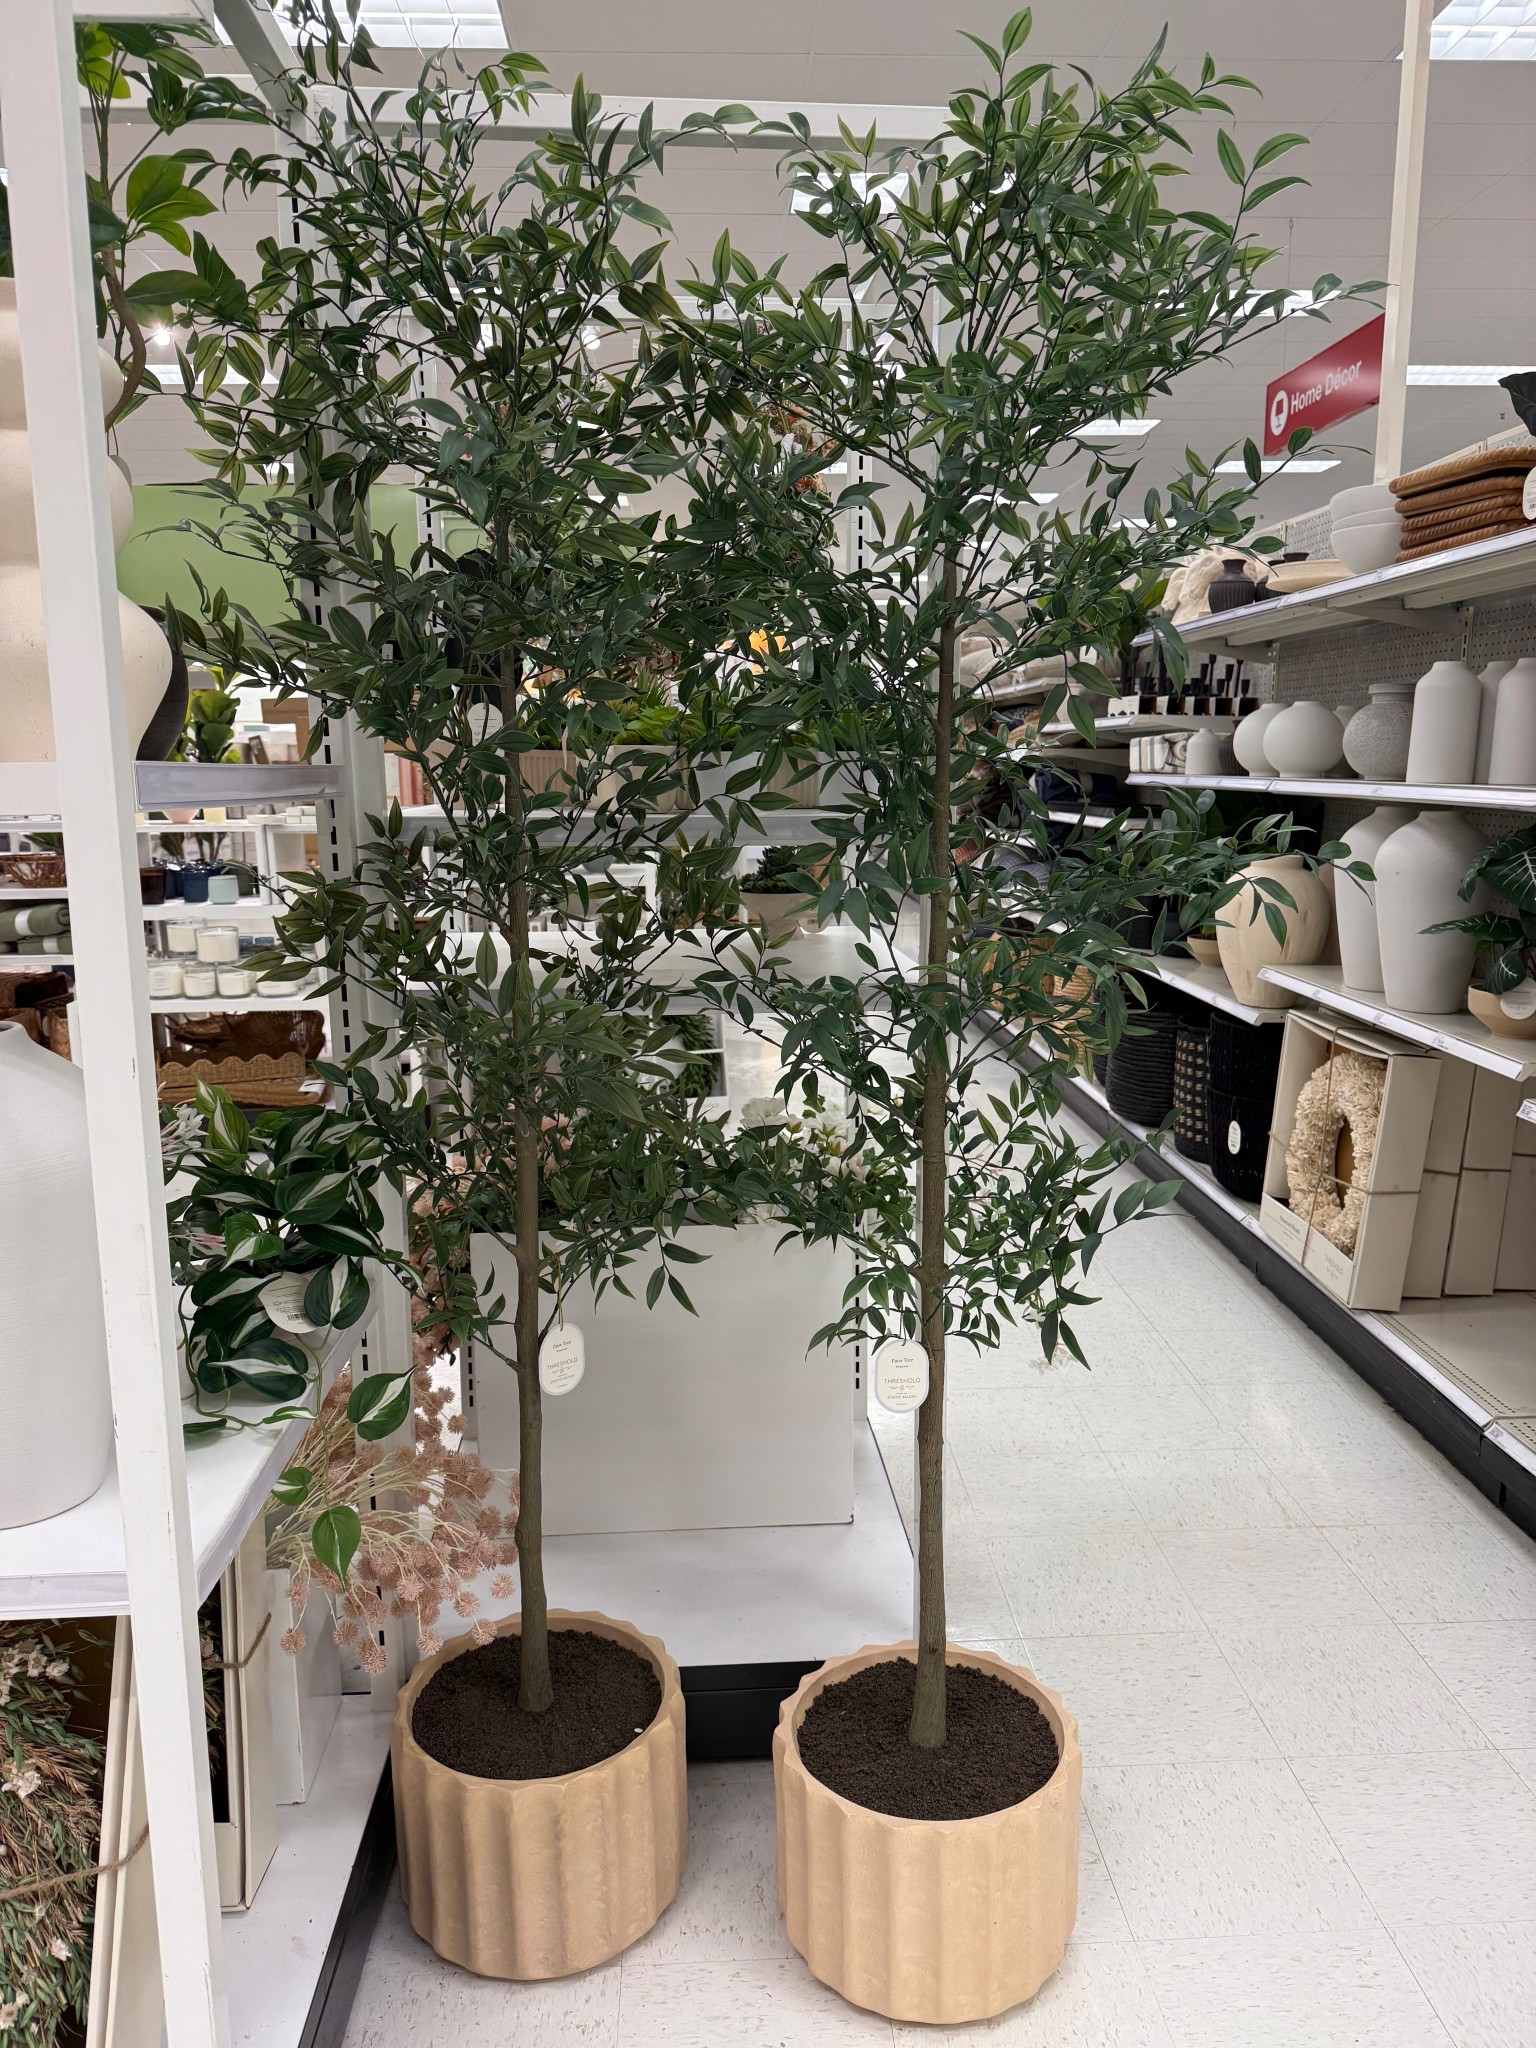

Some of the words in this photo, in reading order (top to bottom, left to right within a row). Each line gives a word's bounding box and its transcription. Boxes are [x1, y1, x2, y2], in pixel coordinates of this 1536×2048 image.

[1290, 384, 1322, 415] Home
[1325, 360, 1362, 396] Décor
[547, 1357, 578, 1370] THRESHOLD
